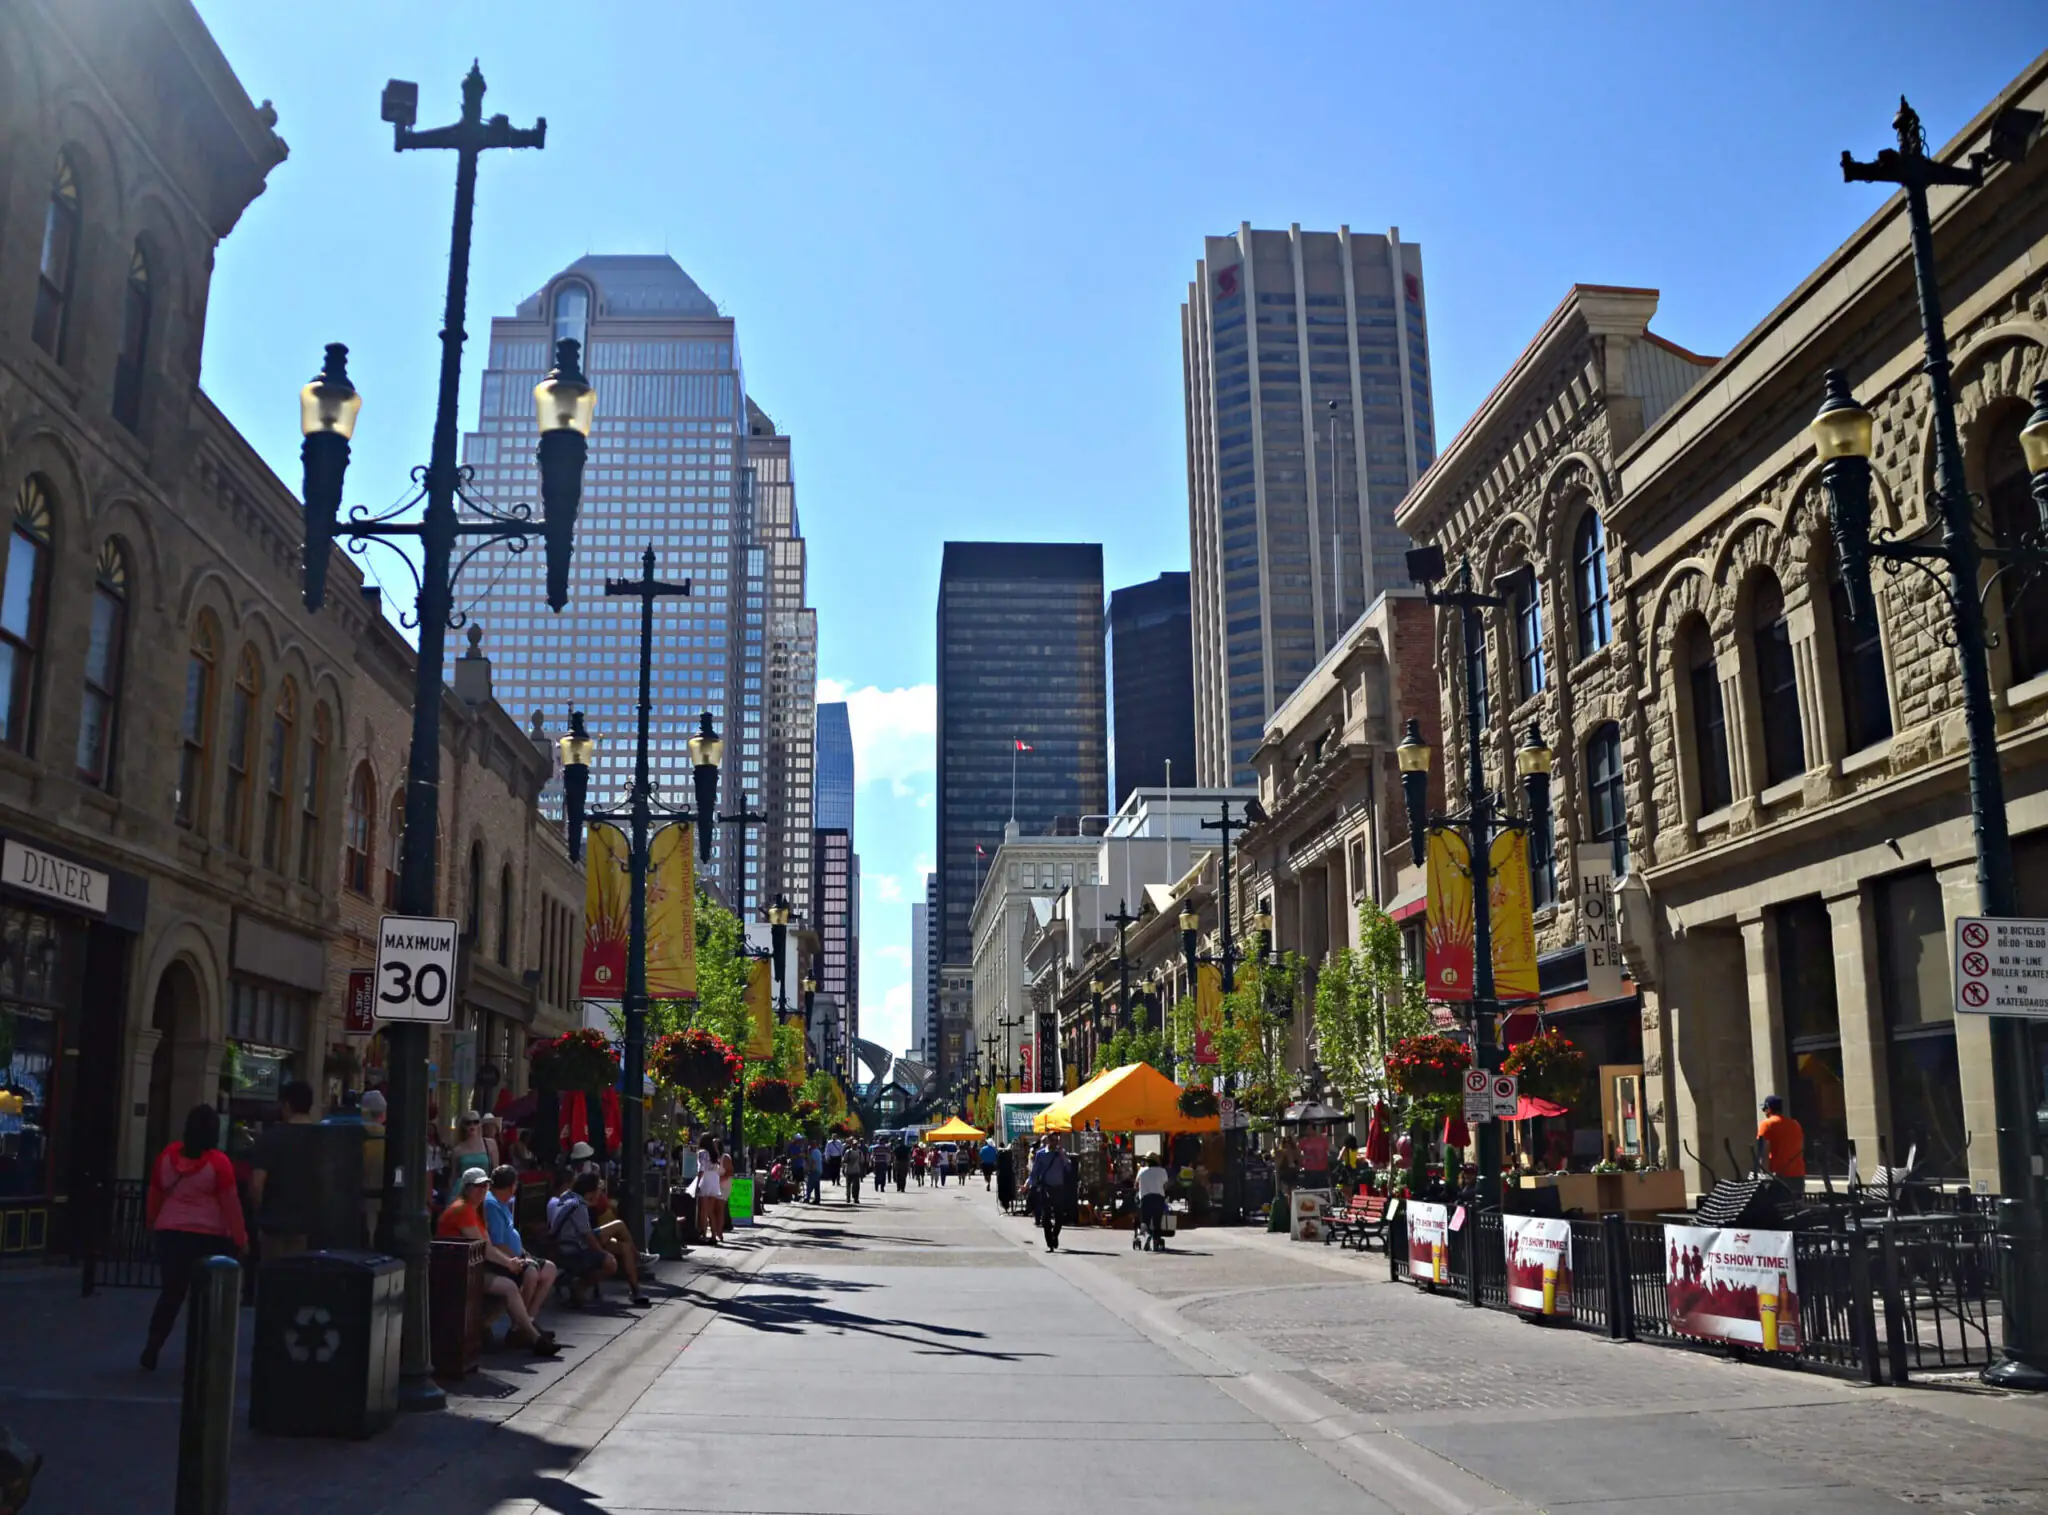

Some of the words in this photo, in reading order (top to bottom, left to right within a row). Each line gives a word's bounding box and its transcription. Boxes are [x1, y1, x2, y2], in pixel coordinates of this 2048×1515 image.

[22, 850, 91, 903] DINER
[680, 860, 691, 906] Avenue
[1517, 864, 1529, 909] Avenue
[384, 934, 450, 952] MAXIMUM
[681, 910, 692, 960] Stephen
[1521, 911, 1533, 964] Stephen
[1583, 875, 1605, 967] HOME
[1997, 926, 2008, 934] NO
[2010, 926, 2046, 936] BICYCLES
[1991, 968, 2019, 977] ROLLER
[1999, 956, 2010, 965] NO
[2012, 957, 2042, 966] IN-LINE
[361, 976, 373, 1029] ORIGINAL
[379, 961, 447, 1007] 30
[1996, 997, 2048, 1008] SKATEBOARDS
[2017, 985, 2028, 994] NO
[1724, 1253, 1754, 1266] SHOW
[1756, 1255, 1789, 1269] TIME!
